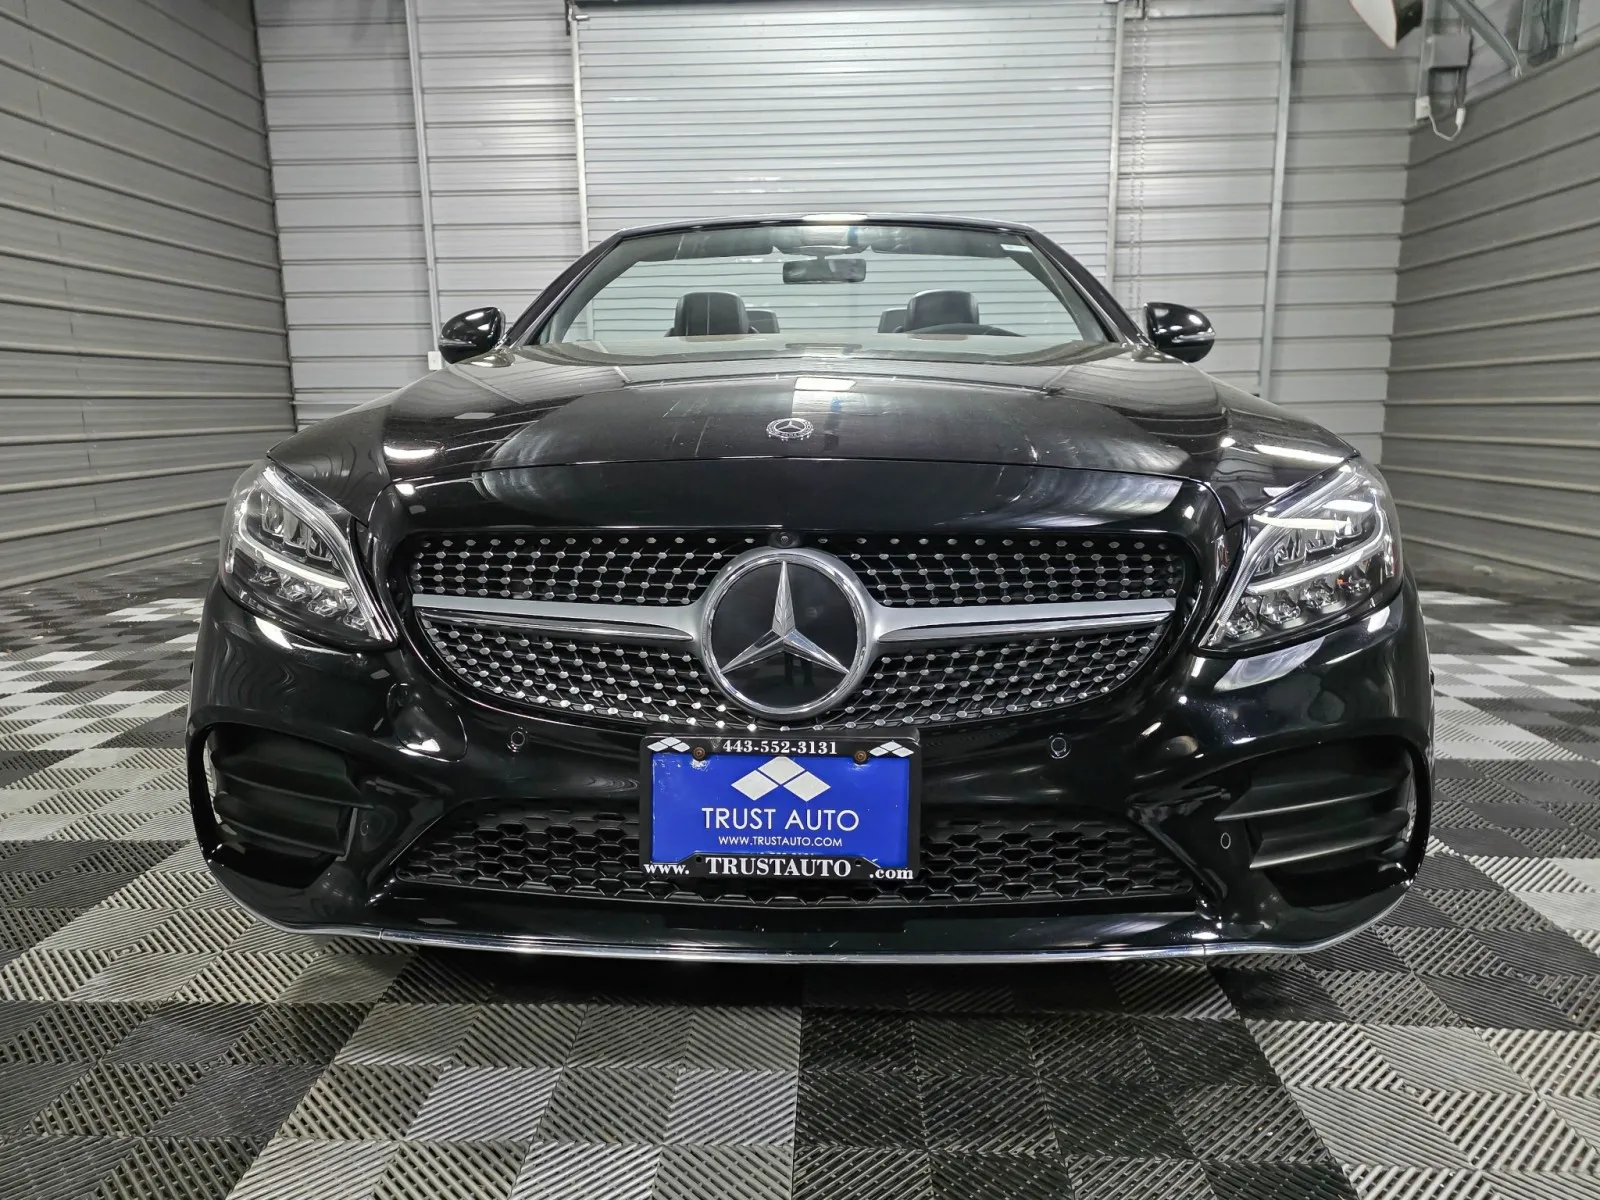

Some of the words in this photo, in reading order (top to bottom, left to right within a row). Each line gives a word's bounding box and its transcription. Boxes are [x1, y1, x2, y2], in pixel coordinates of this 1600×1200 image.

[722, 740, 838, 755] 443-552-3131
[701, 807, 776, 830] TRUST
[784, 808, 859, 831] AUTO
[718, 836, 843, 847] WWW.TRUSTAUTO.COM
[643, 863, 690, 875] www.
[705, 857, 852, 877] TRUSTAUTO
[869, 867, 914, 880] .com
